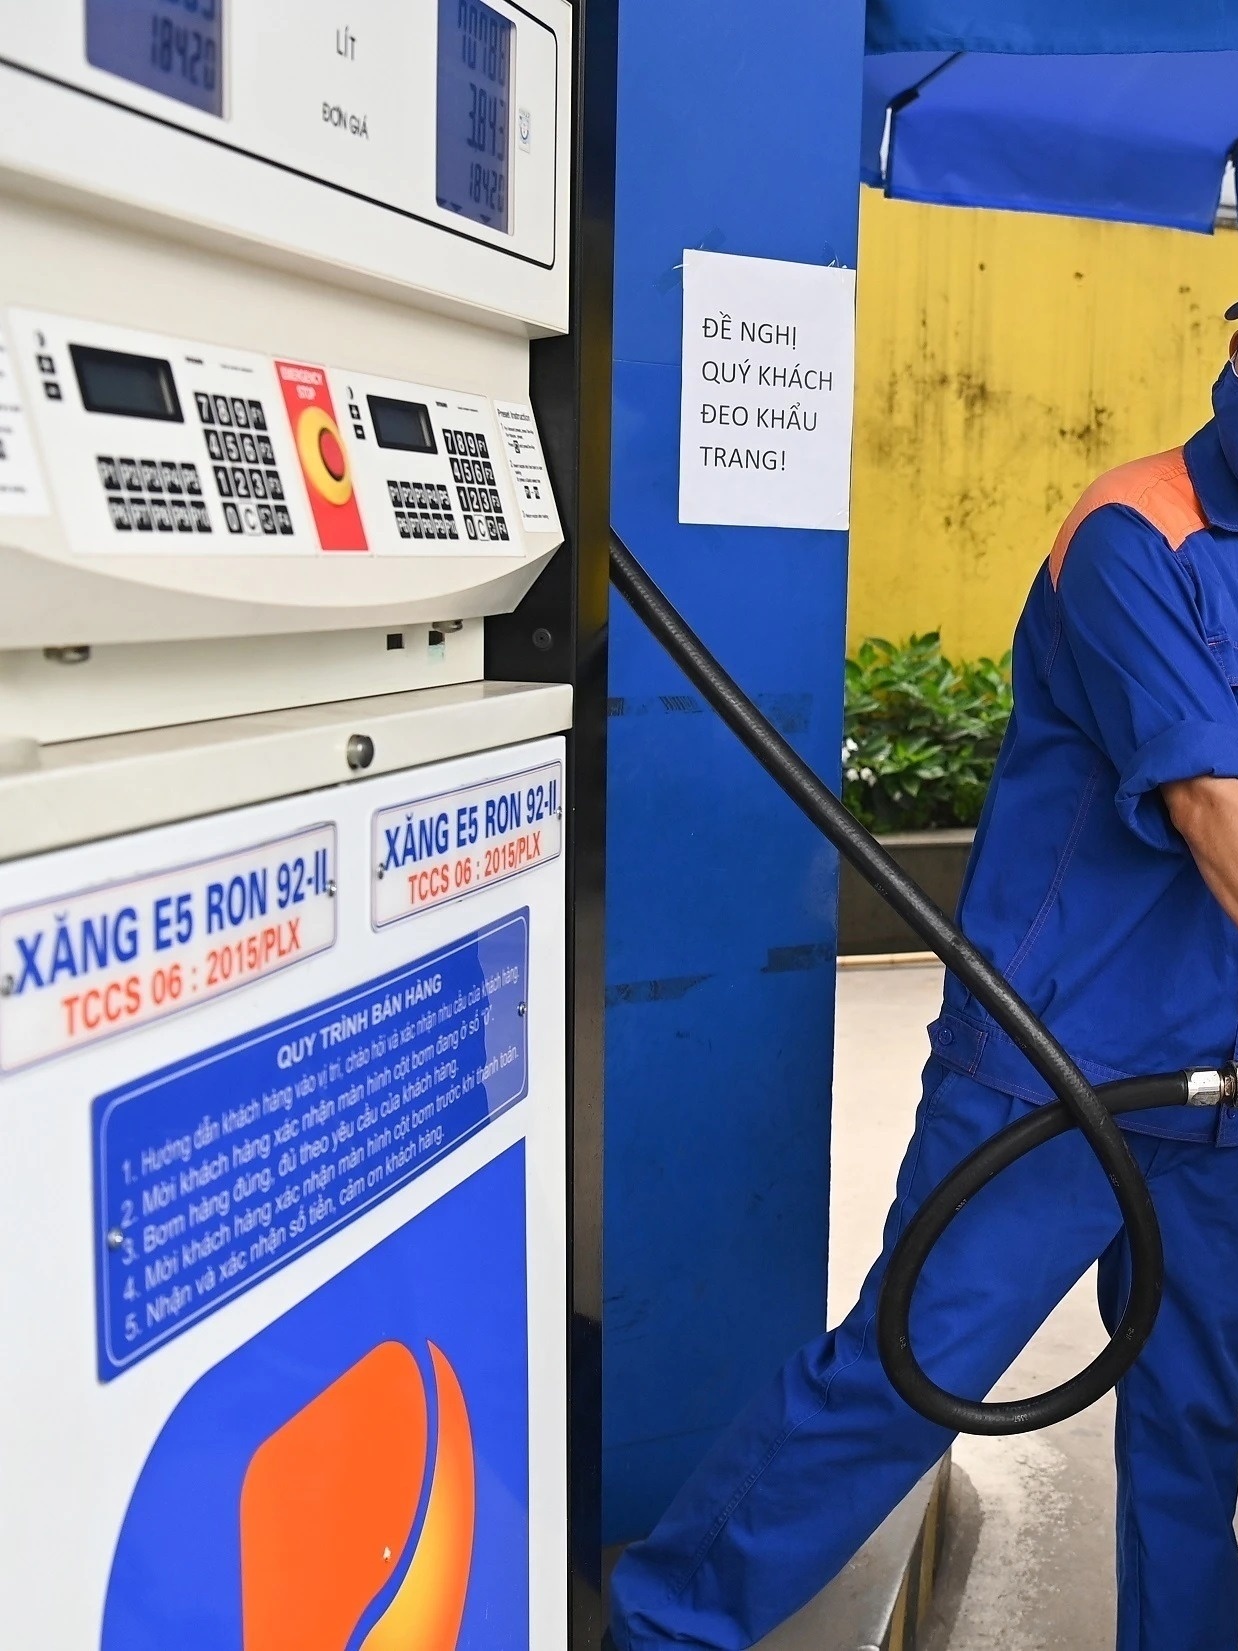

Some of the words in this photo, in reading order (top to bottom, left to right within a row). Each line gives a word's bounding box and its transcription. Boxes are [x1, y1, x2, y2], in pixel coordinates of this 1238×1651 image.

[336, 25, 356, 61] LÍT
[349, 114, 369, 141] GIÁ
[702, 311, 732, 340] ĐỀ
[741, 321, 797, 350] NGHỊ
[702, 359, 750, 385] QUÝ
[758, 364, 833, 391] KHÁCH
[216, 397, 230, 423] 8
[233, 400, 247, 426] 9
[700, 403, 749, 426] ĐEO
[757, 402, 818, 431] KHẨU
[208, 433, 221, 458] 4
[226, 434, 239, 460] 5
[243, 436, 256, 461] 6
[700, 446, 786, 471] TRANG!
[235, 471, 248, 496] 2
[252, 472, 265, 497] 3
[385, 812, 449, 871] XĂNG
[457, 806, 478, 848] E5
[485, 791, 521, 838] RON
[408, 864, 449, 904] TCCS
[455, 858, 471, 888] 06
[484, 831, 541, 877] 2015/PLX
[15, 907, 138, 994] XĂNG
[154, 894, 192, 950] E5
[206, 868, 267, 934] RON
[62, 976, 141, 1036] TCCS
[152, 964, 182, 1005] 06
[206, 917, 302, 986] 2015/PLX
[277, 1033, 317, 1069] QUY
[320, 1009, 368, 1049] TRÌNH
[372, 994, 401, 1025] BÁN
[405, 974, 442, 1008] HÀNG
[121, 1200, 138, 1229] 2.
[180, 1152, 229, 1196] khách
[232, 1133, 271, 1168] hàng
[273, 1117, 300, 1146] xác
[122, 1237, 139, 1266] 3.
[189, 1190, 230, 1228] hàng
[300, 1135, 329, 1166] theo
[332, 1120, 354, 1152] yêu
[402, 1071, 432, 1104] khách
[122, 1159, 138, 1185] 1.
[123, 1275, 140, 1301] 4.
[182, 1222, 231, 1269] khách
[234, 1201, 272, 1239] hàng
[274, 1184, 300, 1214] xác
[462, 1070, 475, 1095] khi
[476, 1058, 498, 1084] thanh
[125, 1312, 142, 1341] 5.
[195, 1265, 216, 1295] và
[219, 1250, 248, 1282] xác
[385, 1142, 416, 1176] khách
